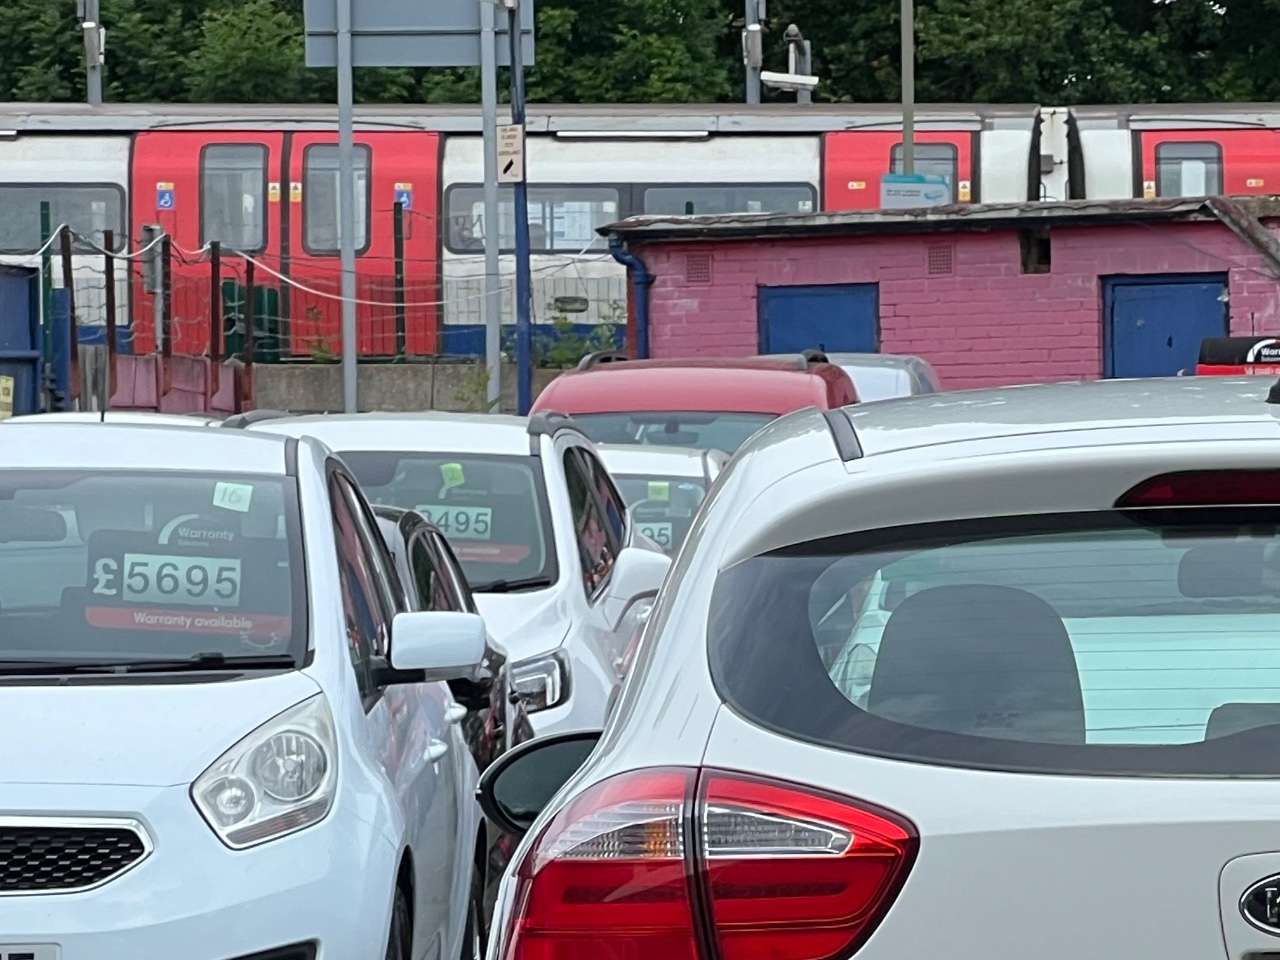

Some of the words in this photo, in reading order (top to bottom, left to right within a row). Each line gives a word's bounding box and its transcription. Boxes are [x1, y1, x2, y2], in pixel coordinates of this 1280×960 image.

[92, 557, 239, 599] £5695
[133, 612, 192, 629] Warranty
[194, 617, 254, 629] available
